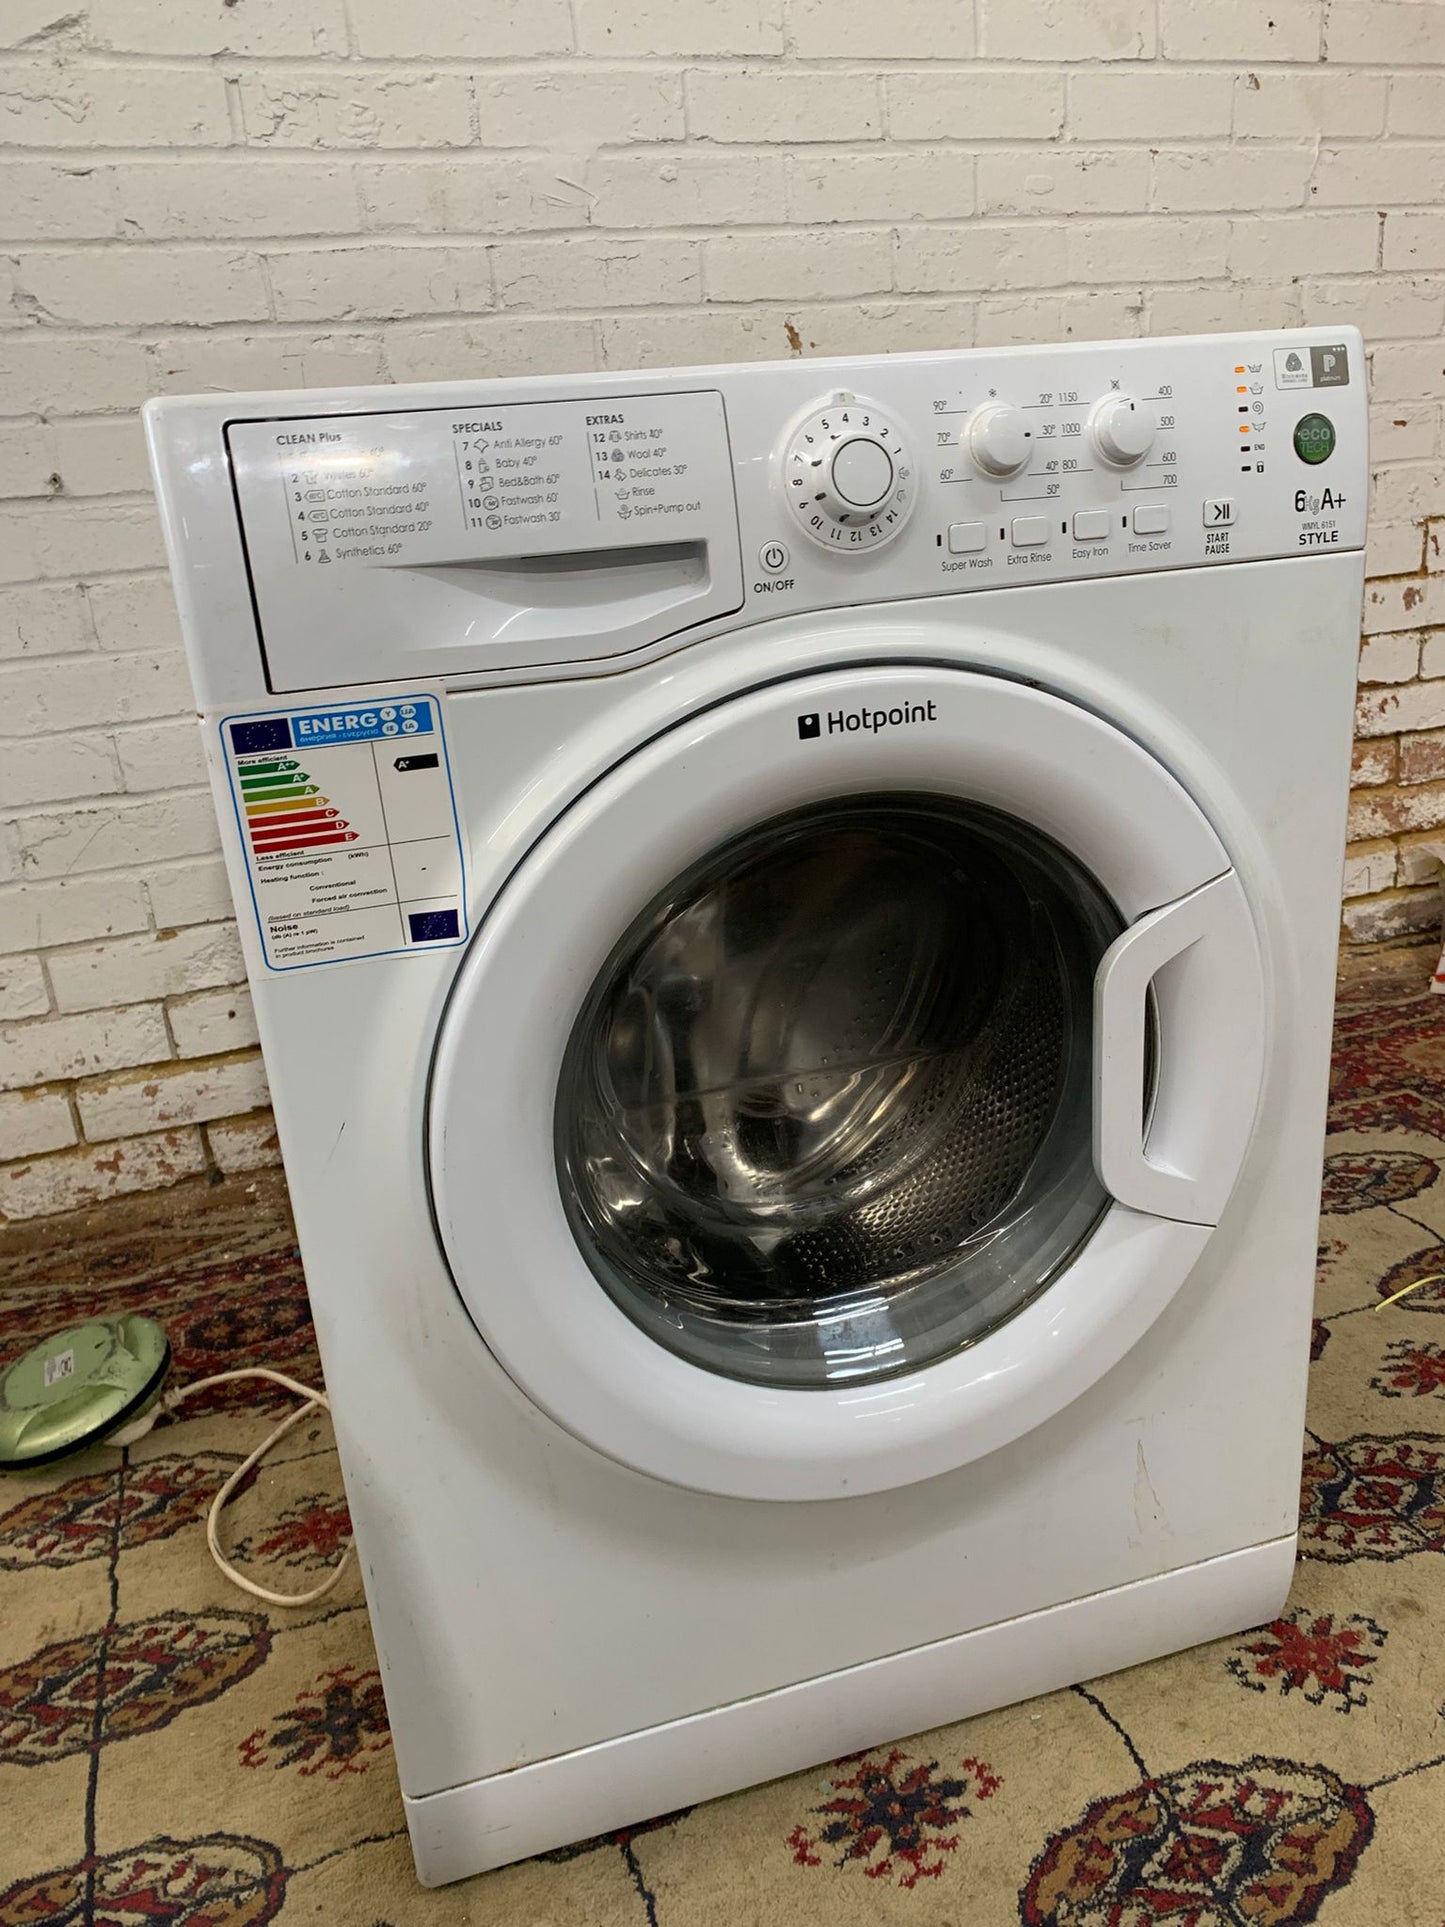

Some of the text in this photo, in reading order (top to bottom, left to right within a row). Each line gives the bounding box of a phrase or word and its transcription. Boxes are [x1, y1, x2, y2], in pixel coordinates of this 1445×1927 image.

[1059, 392, 1078, 402] 1150
[1158, 385, 1172, 396] 400
[585, 414, 624, 426] EXTRAS
[821, 419, 830, 430] 5
[842, 413, 849, 423] 4
[862, 416, 870, 426] 3
[1160, 416, 1175, 426] 500
[452, 421, 503, 434] SPECIALS
[880, 428, 889, 438] 2
[1061, 423, 1080, 433] 1000
[275, 432, 342, 446] CLEAN Plus
[593, 433, 606, 443] 12
[624, 430, 647, 441] Shirts
[1300, 428, 1331, 441] eco
[462, 441, 469, 451] 7
[493, 438, 513, 449] Anti
[514, 437, 546, 450] Allergy
[1254, 443, 1265, 451] END
[595, 451, 608, 461] 13
[627, 448, 650, 460] Wool
[794, 455, 804, 463] 7
[1162, 452, 1176, 463] 600
[465, 460, 472, 470] 8
[496, 458, 520, 469] Baby
[1062, 459, 1077, 470] 800
[291, 474, 299, 483] 2
[598, 470, 610, 480] 14
[629, 466, 672, 479] Delicates
[1163, 474, 1177, 484] 700
[467, 479, 474, 489] 9
[498, 476, 544, 488] Bed&Bath
[792, 478, 803, 486] 8
[295, 493, 302, 502] 3
[327, 487, 362, 500] Cotton
[363, 484, 409, 498] Standard
[631, 486, 655, 497] Rinse
[468, 498, 481, 508] 10
[501, 494, 544, 506] Fastwash
[298, 511, 305, 521] 4
[330, 507, 365, 519] Cotton
[366, 503, 412, 517] Standard
[633, 501, 701, 517] Spin+Pump out
[471, 517, 482, 527] 11
[504, 513, 547, 525] Fastwash
[810, 515, 824, 530] 10
[886, 509, 898, 524] 14
[301, 531, 308, 541] 5
[332, 526, 368, 539] Cotton
[369, 522, 416, 536] Standard
[830, 527, 841, 541] 11
[850, 531, 863, 542] 12
[870, 524, 883, 537] 13
[1206, 532, 1229, 544] START
[1299, 531, 1339, 546] STYLE
[304, 551, 311, 561] 6
[335, 544, 385, 559] Synthetics
[1072, 546, 1109, 559] Easy Iron
[1128, 540, 1172, 553] Time Saver
[1205, 543, 1230, 555] PAUSE
[941, 557, 993, 573] Super Wash
[1007, 552, 1052, 565] Extra Rinse
[753, 579, 795, 593] ON/OFF
[298, 712, 378, 735] ENERG
[828, 700, 937, 734] Hotpoint
[304, 786, 314, 795] A
[316, 798, 324, 806] B
[325, 809, 335, 818] C
[335, 821, 344, 829] D
[345, 833, 353, 841] E
[256, 854, 274, 862] Less
[258, 857, 333, 872] Energy consumption
[260, 871, 320, 884] Heating function
[309, 880, 357, 892] Conventional
[312, 894, 337, 904] Forced
[349, 887, 388, 899] convection
[270, 924, 298, 933] Noise
